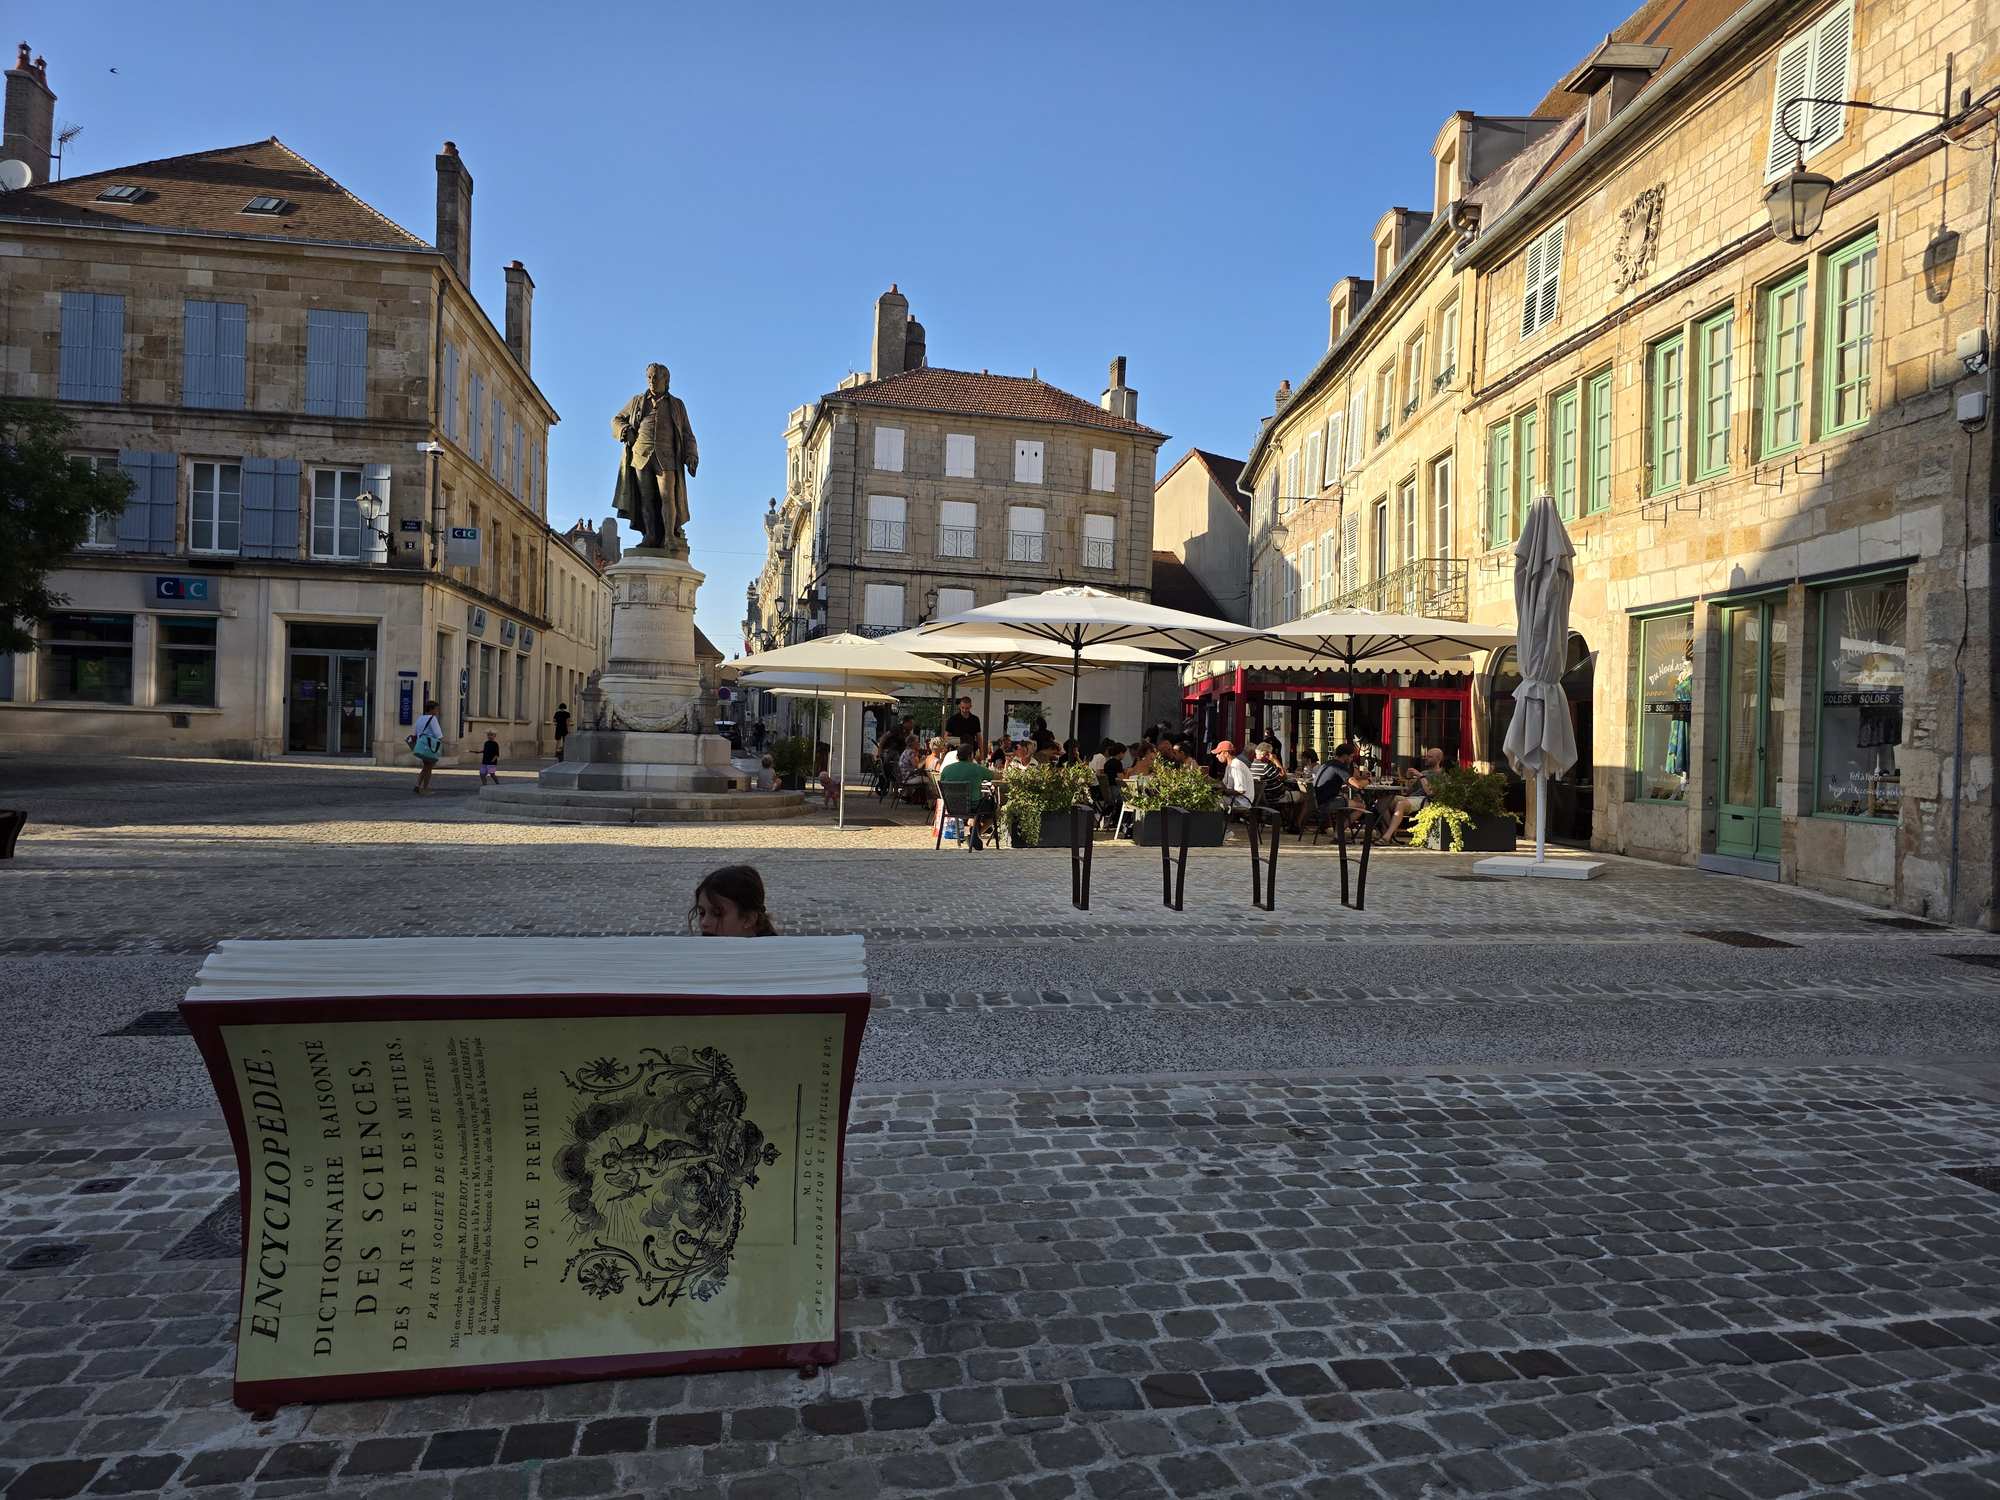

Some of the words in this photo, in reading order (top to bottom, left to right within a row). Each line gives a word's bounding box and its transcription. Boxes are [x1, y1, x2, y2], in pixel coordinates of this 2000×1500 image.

[454, 530, 474, 538] CIC
[161, 581, 203, 597] CIC
[1824, 694, 1852, 704] SOLDES
[1859, 694, 1890, 704] SOLDES
[823, 1063, 831, 1076] DU
[298, 1039, 342, 1139] RAISONNÉ
[430, 1108, 441, 1124] DE
[348, 1060, 384, 1222] SCIENCES,
[432, 1128, 444, 1160] GENS
[522, 1087, 541, 1181] PREMIER.
[401, 1132, 417, 1168] DES
[484, 1155, 493, 1163] de
[818, 1149, 825, 1163] ET
[304, 1164, 314, 1188] OU
[434, 1166, 445, 1184] DE
[459, 1168, 468, 1176] de
[483, 1165, 495, 1186] Paris,
[243, 1049, 290, 1343] ENCYCLOPÉDIE,
[403, 1182, 418, 1212] ET
[472, 1182, 480, 1215] PARTIE
[485, 1190, 492, 1199] de
[481, 1202, 492, 1232] Sciences
[816, 1171, 824, 1270] APPROBATION
[458, 1233, 466, 1243] M.
[484, 1235, 492, 1247] des
[523, 1199, 540, 1268] TOME
[314, 1156, 344, 1357] DICTIONNAIRE
[400, 1228, 416, 1290] ARTS
[460, 1246, 468, 1258] par
[468, 1256, 478, 1265] &
[355, 1246, 382, 1316] DES
[430, 1256, 442, 1285] UNE
[456, 1285, 464, 1293] &
[427, 1292, 440, 1320] PAR
[454, 1296, 464, 1318] ordre
[467, 1296, 475, 1306] de
[491, 1286, 501, 1321] Londres.
[392, 1306, 410, 1352] DES
[454, 1320, 461, 1330] en
[464, 1307, 475, 1336] Lettres
[480, 1326, 487, 1335] de
[491, 1324, 499, 1334] de
[450, 1333, 460, 1348] Mis
